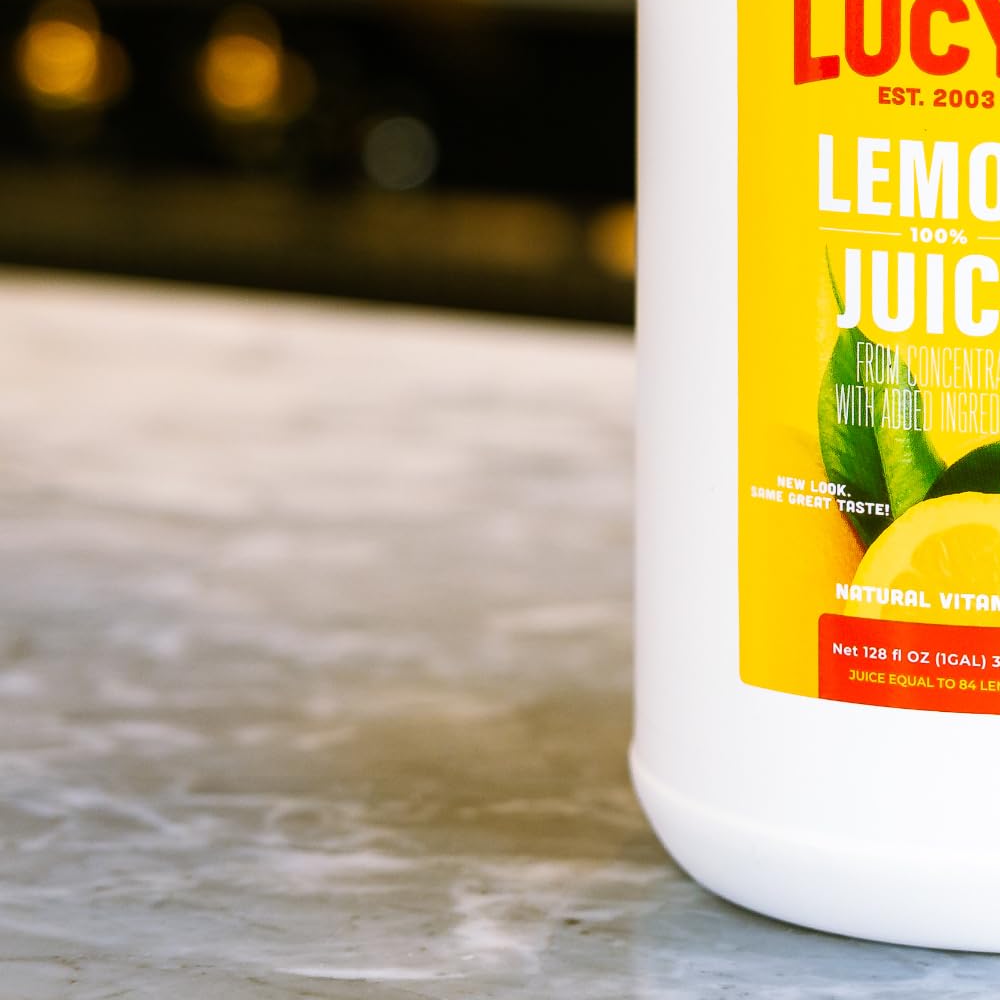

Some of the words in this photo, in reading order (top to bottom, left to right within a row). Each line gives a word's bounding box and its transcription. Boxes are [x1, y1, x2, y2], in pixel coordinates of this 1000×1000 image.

[878, 86, 924, 106] EST.
[933, 89, 995, 109] 2003
[910, 227, 968, 244] 100%
[856, 341, 899, 385] FROM
[836, 384, 874, 427] WITH
[882, 388, 933, 432] ADDED
[777, 475, 806, 489] NEW
[811, 480, 851, 497] LOOK.
[751, 486, 783, 502] SAME
[789, 492, 831, 510] GREAT
[837, 499, 890, 516] TASTE!
[835, 583, 931, 608] NATURAL
[832, 643, 858, 656] Net
[863, 646, 887, 660] 128
[892, 649, 901, 661] fl
[907, 651, 929, 664] OZ
[936, 652, 986, 669] (1GAL)
[849, 670, 885, 683] JUICE
[889, 674, 934, 688] EQUAL
[937, 678, 955, 689] TO
[959, 680, 976, 690] 84
